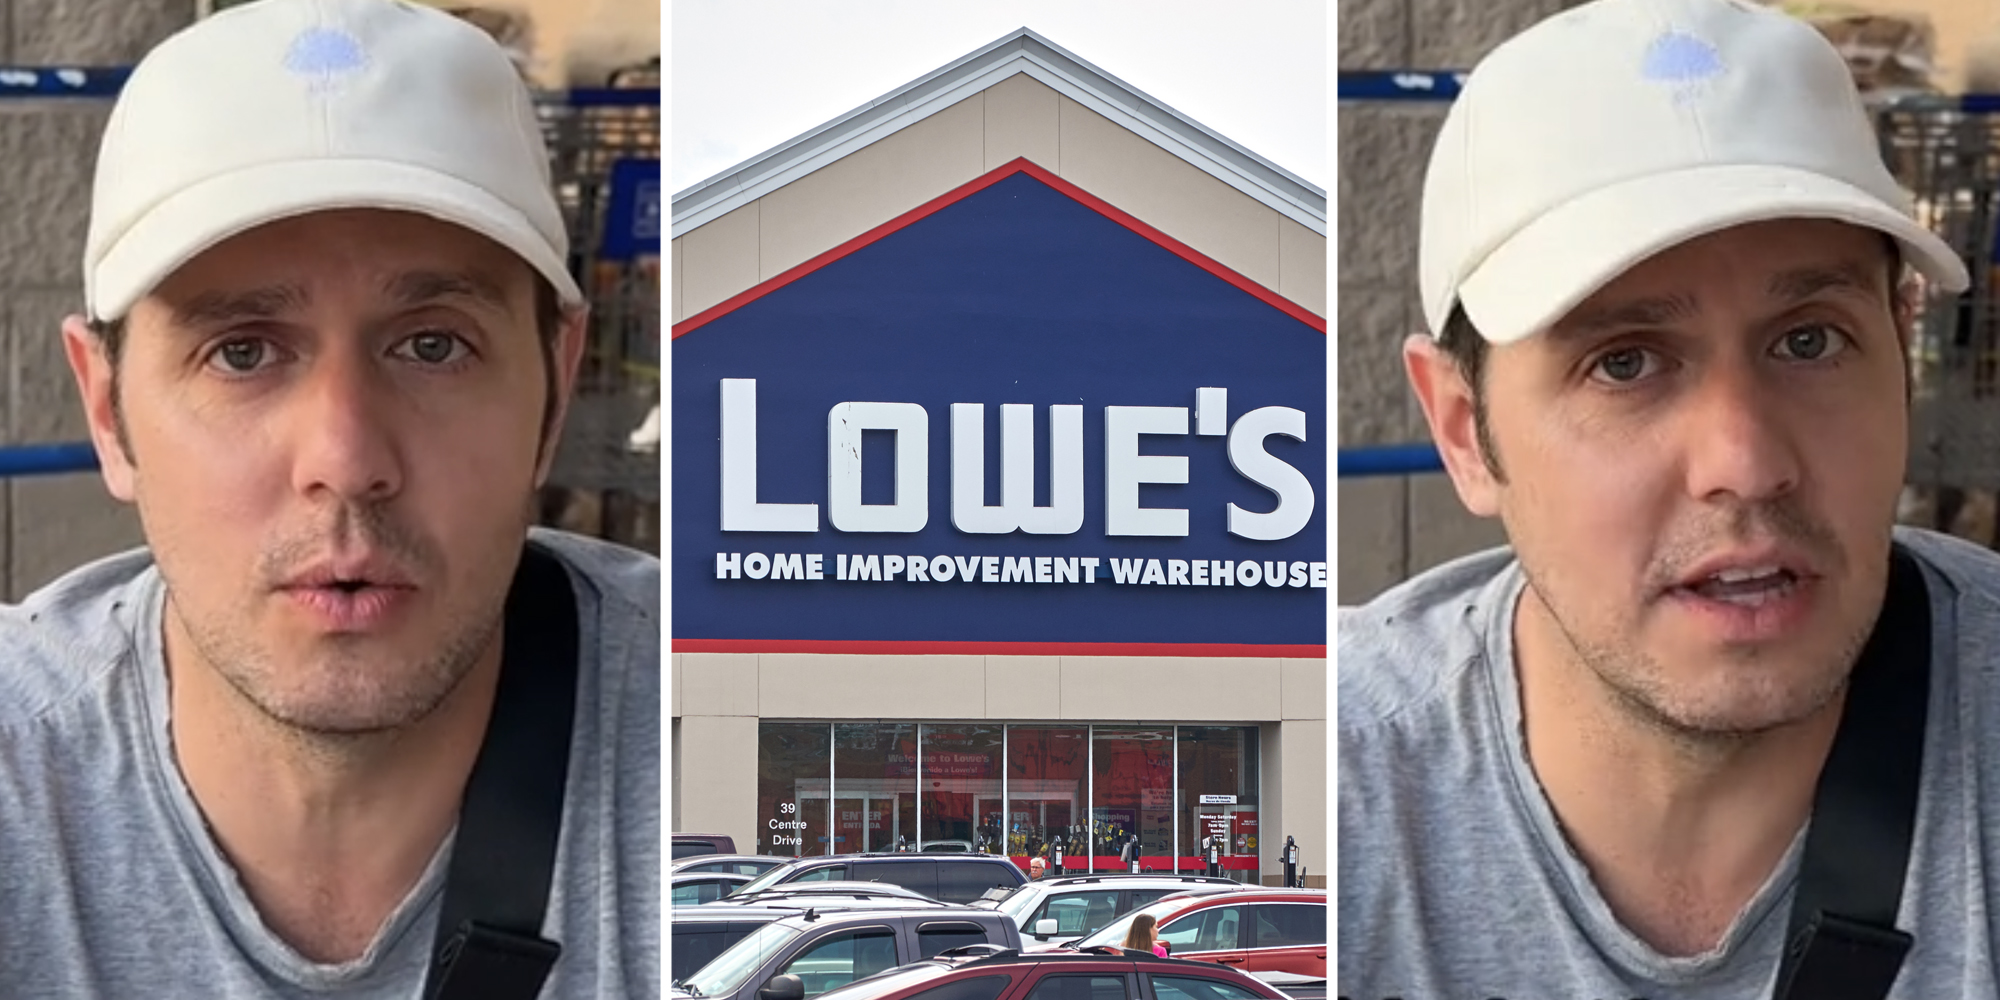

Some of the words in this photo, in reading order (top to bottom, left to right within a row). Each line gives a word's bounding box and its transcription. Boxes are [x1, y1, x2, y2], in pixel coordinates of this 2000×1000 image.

[720, 378, 1315, 541] LOWE'S
[716, 552, 824, 581] HOME
[836, 554, 1100, 585] IMPROVEMENT
[1112, 557, 1326, 589] WAREHOUSE
[888, 754, 936, 763] Welcme
[939, 754, 951, 763] to
[954, 754, 990, 763] Lowe's
[780, 803, 796, 814] 39
[769, 818, 807, 831] Centre
[773, 834, 803, 846] Drive
